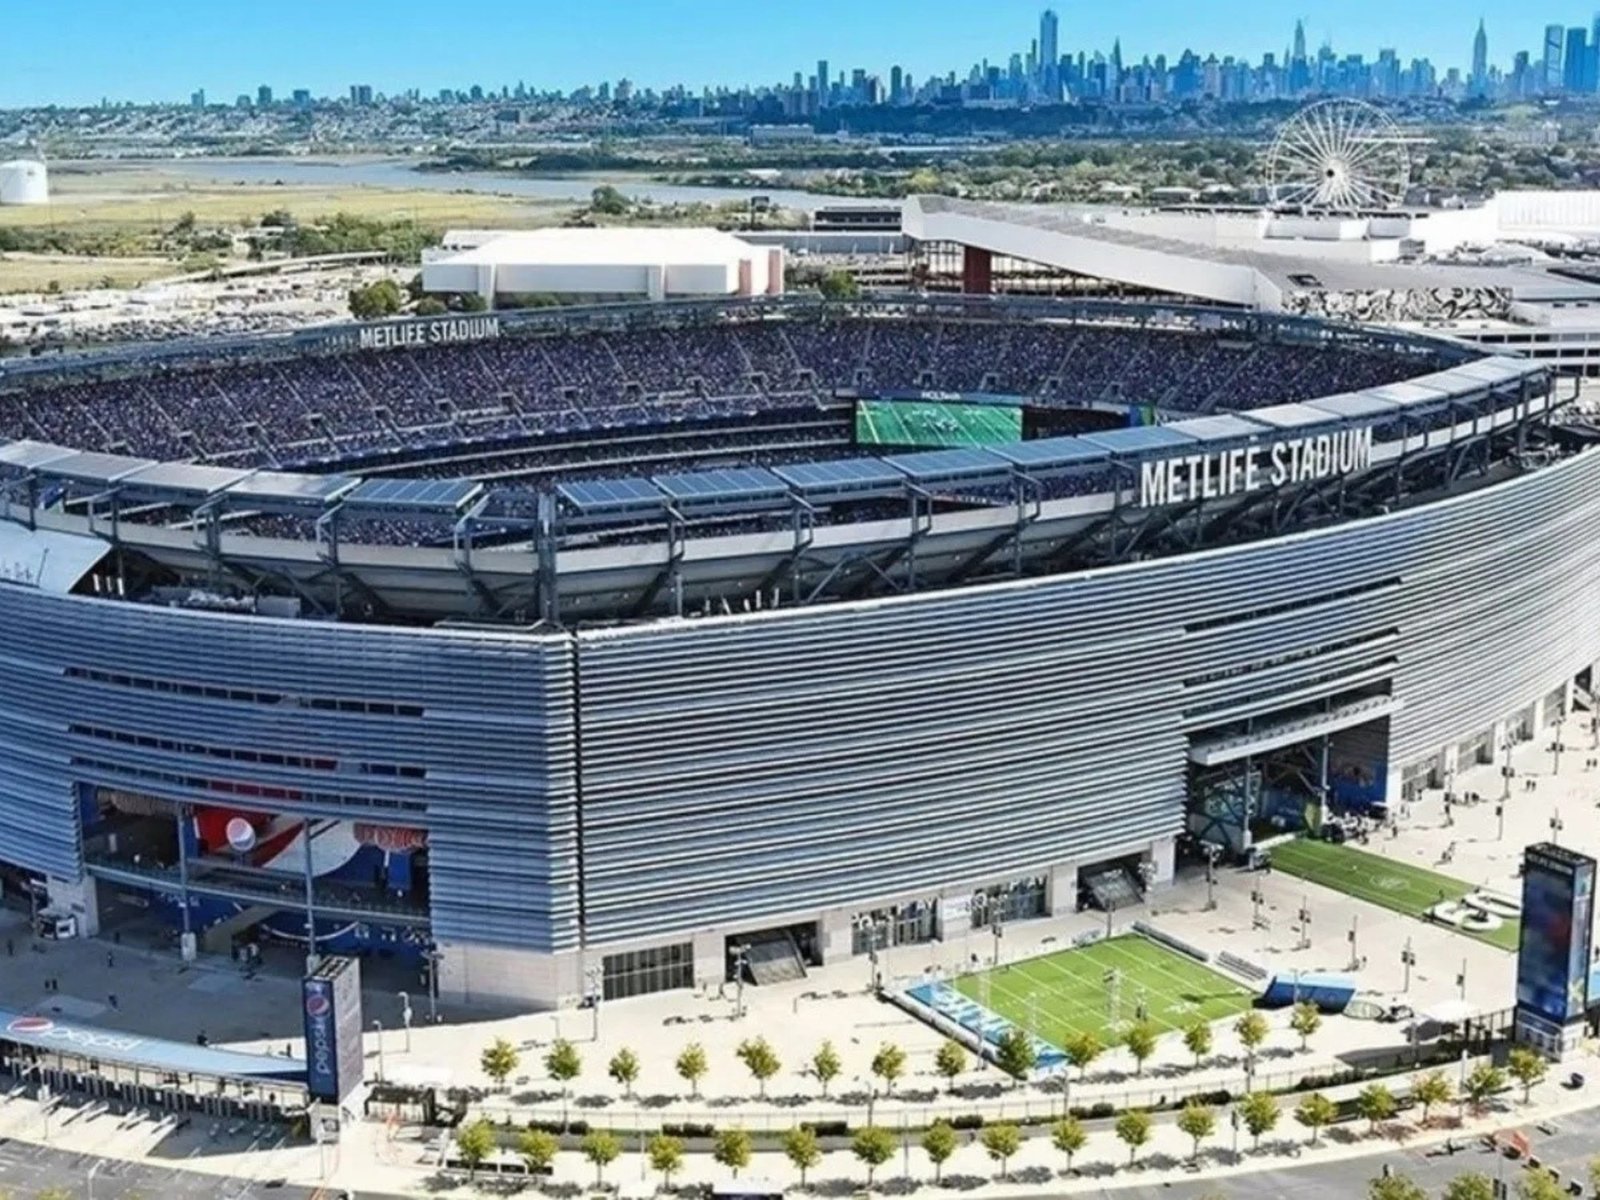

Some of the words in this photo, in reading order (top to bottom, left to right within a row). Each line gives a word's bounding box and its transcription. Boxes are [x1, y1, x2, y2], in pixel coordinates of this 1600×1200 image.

[360, 322, 426, 349] METLIFE
[429, 317, 500, 343] STADIUM
[1140, 445, 1261, 508] METLIFE
[1270, 425, 1374, 487] STADIUM
[312, 1022, 331, 1075] pepsi
